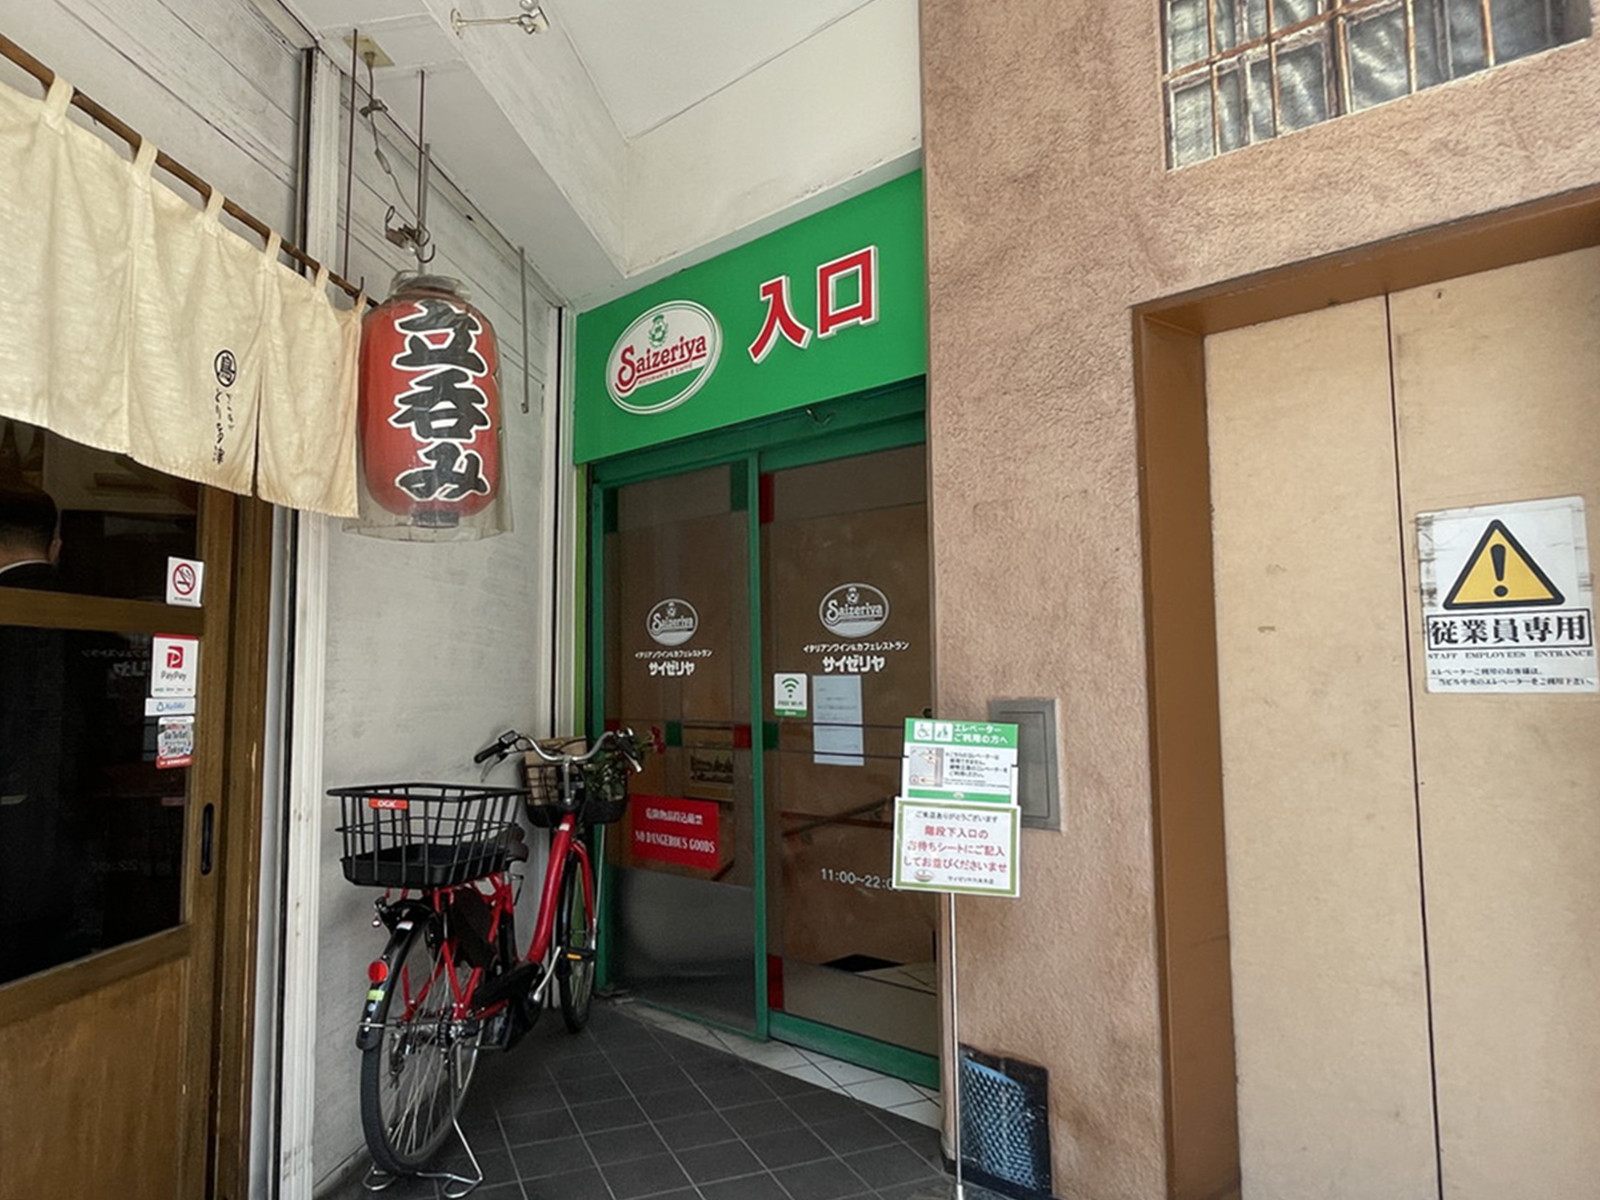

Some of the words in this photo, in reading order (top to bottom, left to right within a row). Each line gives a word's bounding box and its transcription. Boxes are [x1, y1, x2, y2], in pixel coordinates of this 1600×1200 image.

[748, 245, 879, 364] 入口
[617, 335, 707, 388] Saizeriya
[388, 299, 490, 501] 立呑み
[826, 600, 883, 620] Saizeriya
[651, 613, 694, 631] Saizeriya
[1430, 614, 1585, 645] 従業員専用
[1428, 652, 1458, 660] STAFF
[1465, 650, 1526, 659] EMPLOYEES
[1534, 649, 1594, 658] ENTRANCE
[649, 660, 695, 676] サイゼリヤ
[822, 654, 885, 673] サイゼリヤ
[161, 671, 187, 681] PayPay
[954, 724, 1002, 734] エレベーター
[954, 733, 1008, 745] ご利用の方へ
[924, 825, 989, 839] 階段下入口の
[646, 831, 688, 849] DANGEROUS
[689, 838, 716, 854] GOODS
[907, 840, 1005, 857] お待ちシートにご記入
[904, 856, 1007, 873] してお並びくださいませ
